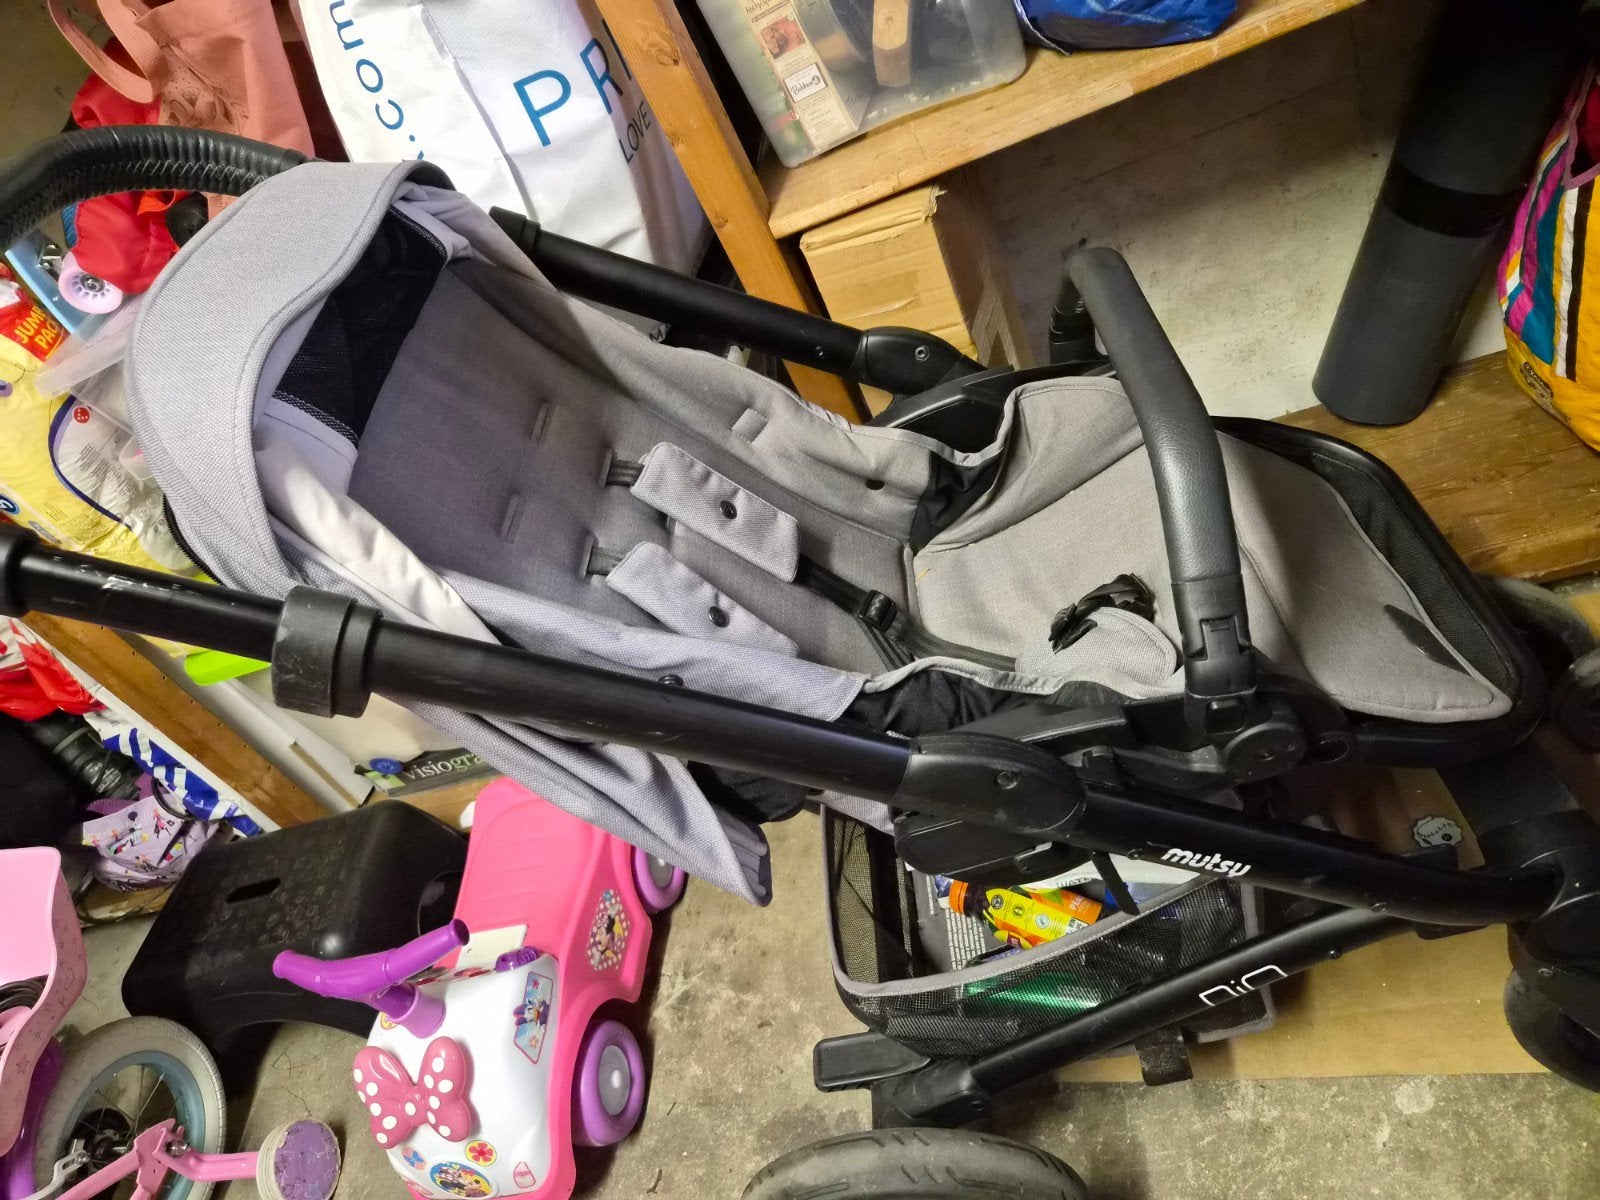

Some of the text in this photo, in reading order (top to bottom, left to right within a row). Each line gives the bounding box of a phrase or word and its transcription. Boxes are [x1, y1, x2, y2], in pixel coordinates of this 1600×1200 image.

[329, 0, 425, 161] .com
[619, 100, 652, 165] LOVE
[1161, 848, 1252, 877] mutsy
